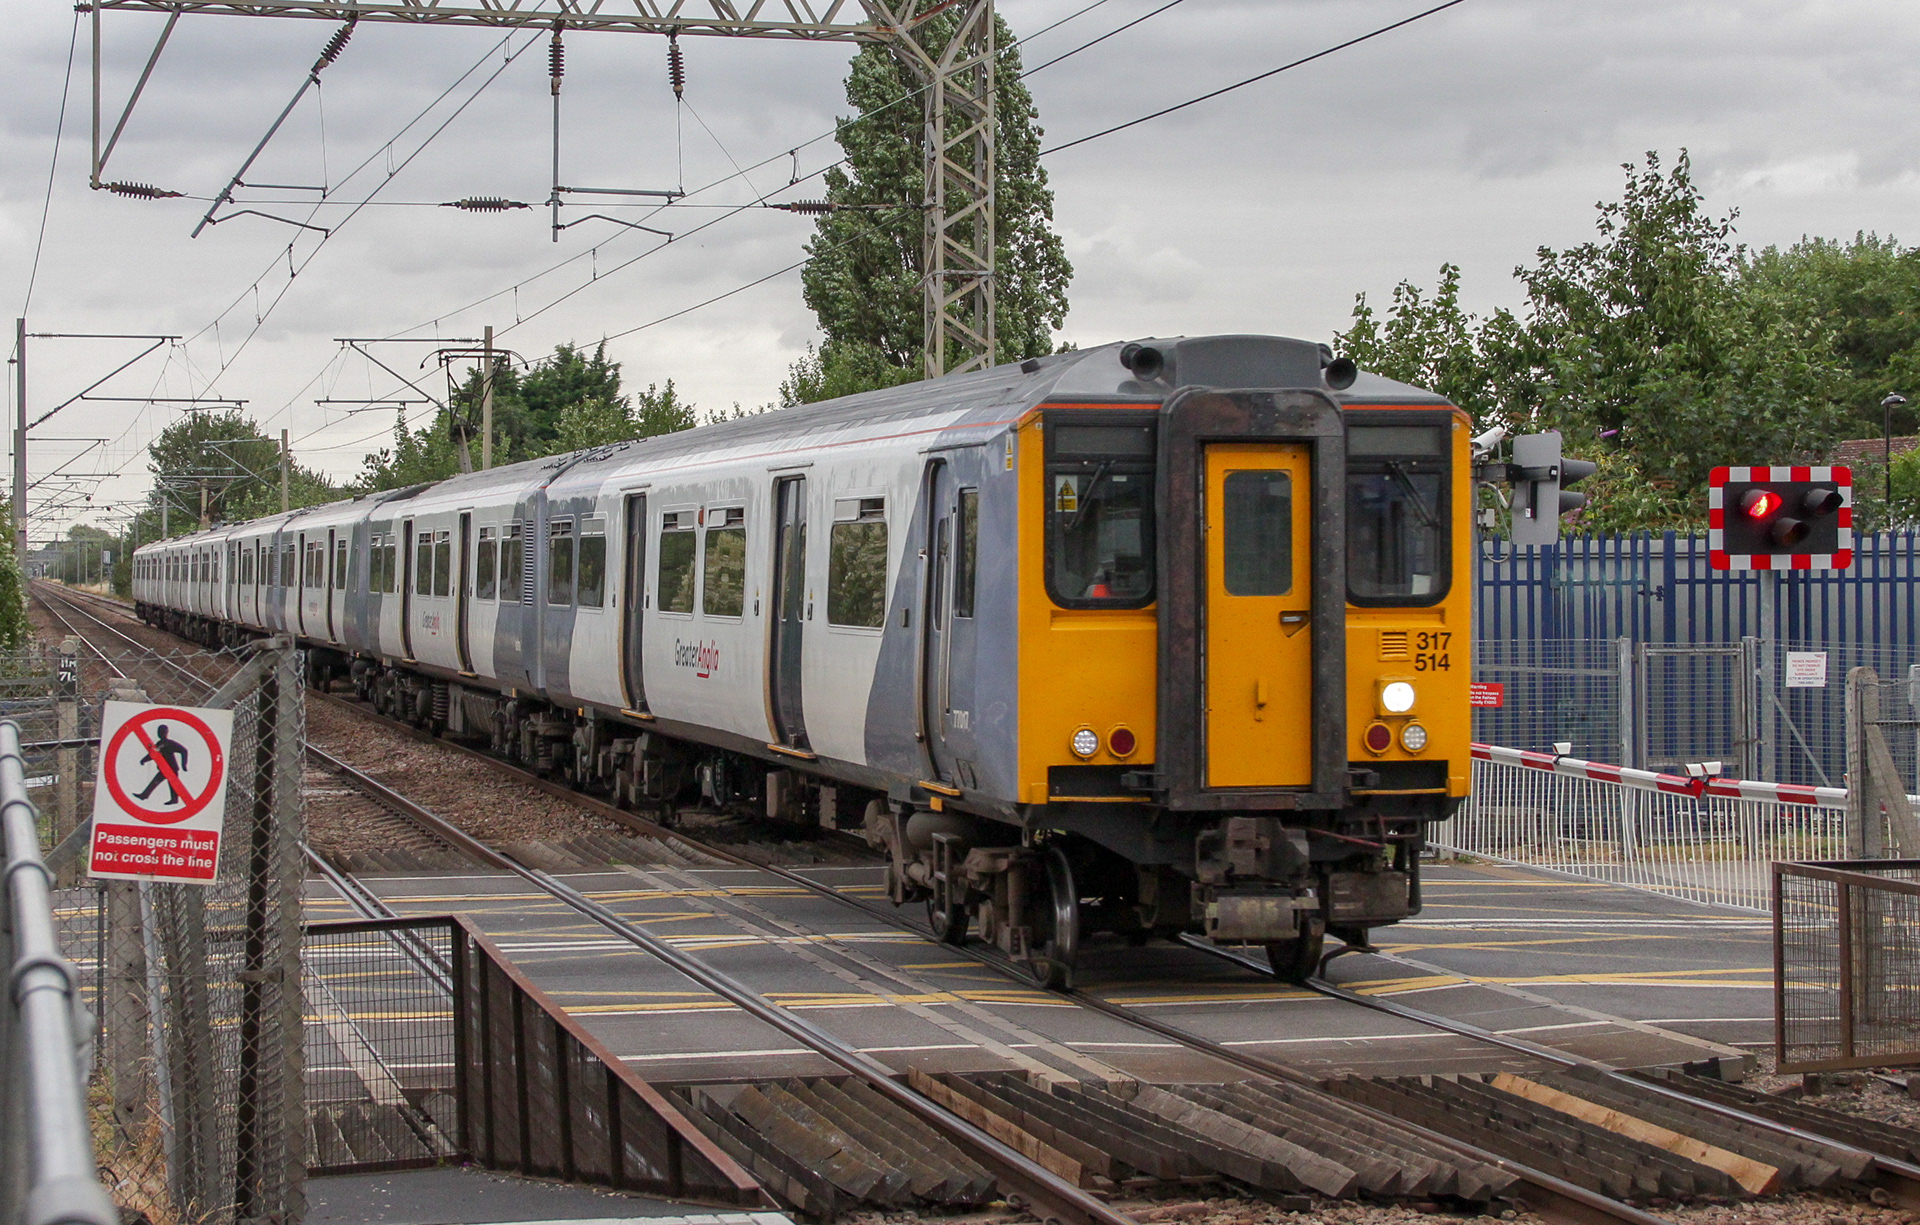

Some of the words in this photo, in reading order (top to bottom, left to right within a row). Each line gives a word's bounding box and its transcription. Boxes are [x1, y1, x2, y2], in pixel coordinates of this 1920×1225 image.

[1416, 632, 1452, 650] 317
[1414, 653, 1451, 671] 514
[97, 832, 177, 849] Passengers
[180, 839, 214, 850] must
[95, 851, 119, 862] not
[122, 853, 159, 864] cross
[162, 854, 184, 866] the
[188, 855, 212, 868] line
